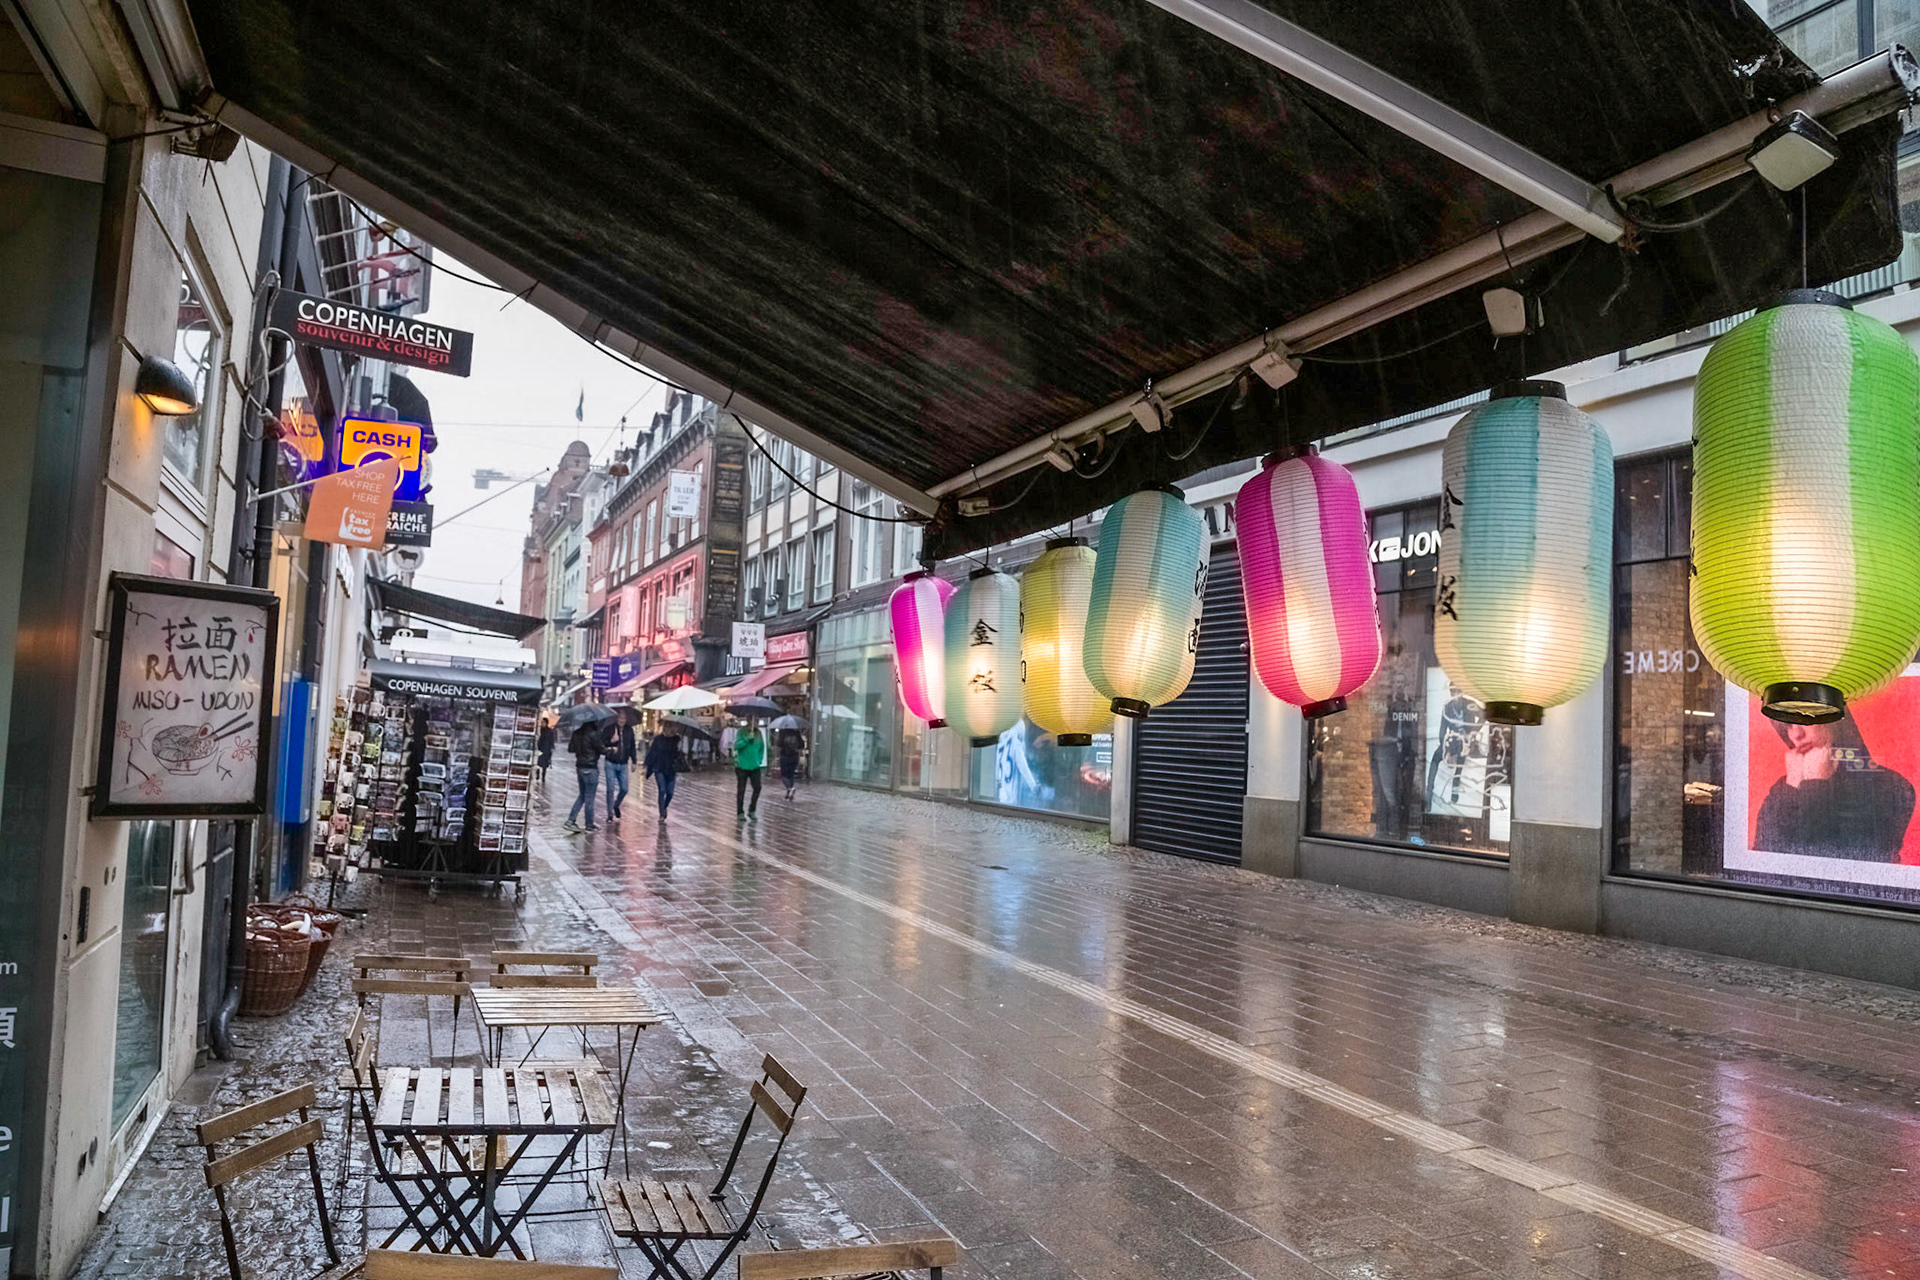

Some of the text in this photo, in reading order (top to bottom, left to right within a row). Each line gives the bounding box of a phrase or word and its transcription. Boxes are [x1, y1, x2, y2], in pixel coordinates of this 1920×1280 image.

[298, 299, 453, 351] COPENHAGEN
[297, 321, 450, 366] souvenir & design
[353, 430, 412, 448] CASH
[354, 469, 386, 481] SHOP
[336, 476, 383, 493] TAX FREE
[352, 492, 380, 505] HERE
[348, 513, 369, 526] tax
[387, 511, 424, 524] REME
[346, 522, 371, 535] free
[160, 616, 238, 652] 拉面
[145, 653, 251, 682] RAMEN
[387, 679, 518, 702] COPENHAGEN SOUVENIR
[132, 689, 180, 711] MISO
[201, 690, 254, 712] UDON
[1392, 712, 1418, 722] DENIM
[1793, 880, 1811, 890] Shop
[1814, 884, 1841, 893] online
[1844, 886, 1854, 894] in
[1858, 888, 1876, 897] this
[1880, 891, 1904, 900] store
